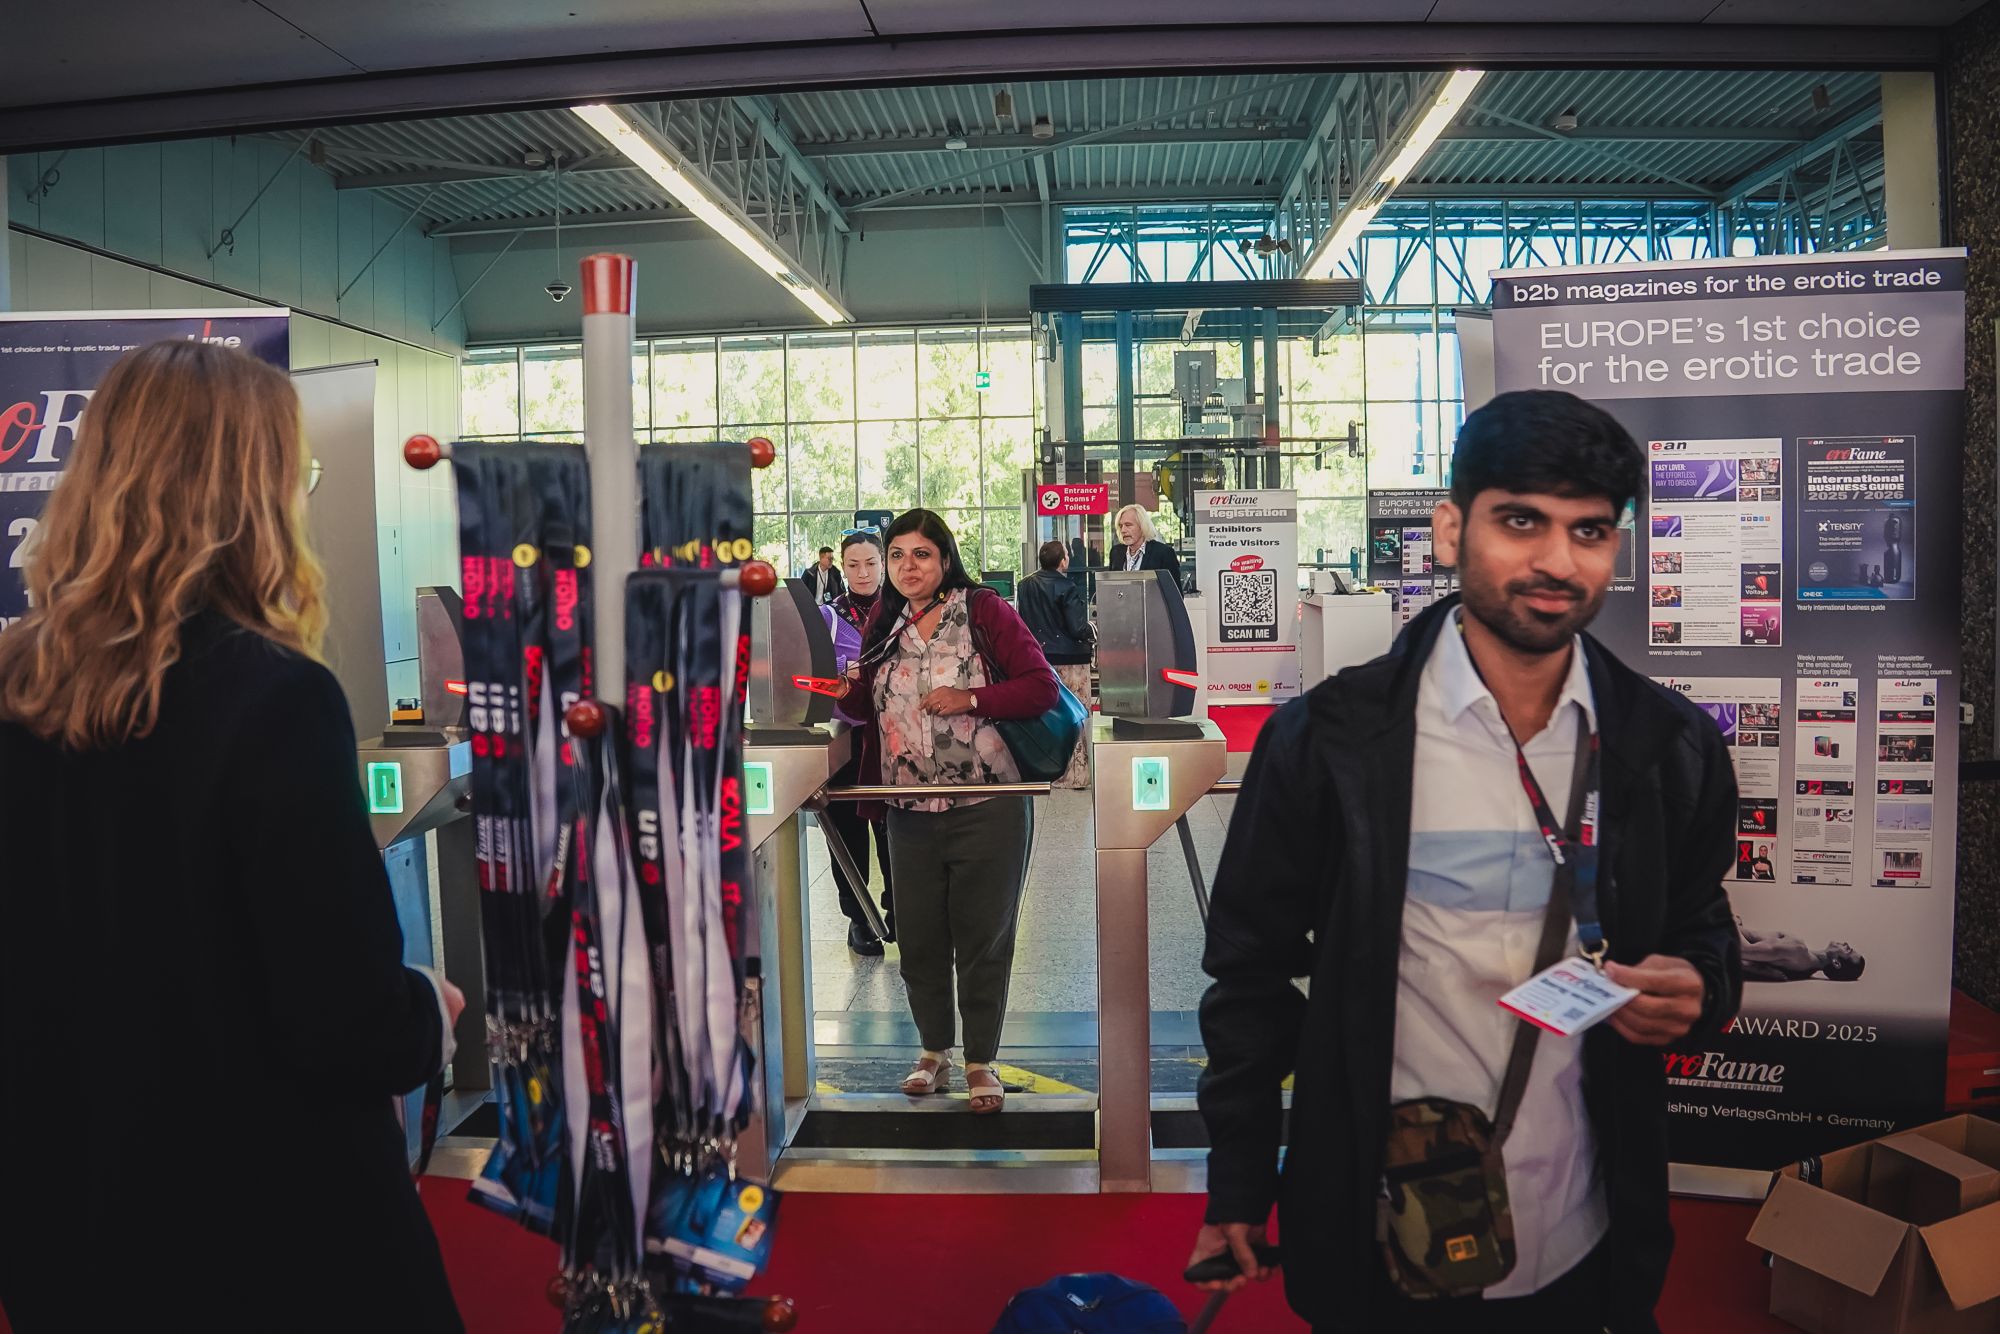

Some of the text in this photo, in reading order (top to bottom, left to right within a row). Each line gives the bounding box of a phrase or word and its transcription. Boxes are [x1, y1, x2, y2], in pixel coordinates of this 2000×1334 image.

[1513, 268, 1942, 302] b2b magazines for the erotic trade
[1540, 311, 1921, 349] EUROPE's 1st choice
[14, 345, 42, 353] choice
[43, 345, 55, 353] for
[57, 344, 71, 352] the
[72, 344, 97, 352] erotic
[98, 343, 121, 352] trade
[1538, 346, 1922, 385] for the erotic trade
[1651, 441, 1688, 451] ean
[1808, 483, 1904, 491] BUSINESS GUIDE
[1808, 491, 1848, 501] 2025
[1863, 490, 1904, 500] 2026
[1422, 499, 1434, 507] 1st
[1209, 508, 1288, 519] Registration
[1378, 508, 1392, 516] for
[1393, 507, 1408, 515] the
[1208, 525, 1262, 533] Exhibitors
[1227, 629, 1270, 639] SCAN ME
[1207, 683, 1225, 691] CALA
[1228, 683, 1252, 692] ORION
[1814, 680, 1839, 688] ean
[1728, 1016, 1878, 1042] AWARD 2025
[1663, 1051, 1785, 1083] roFame
[1712, 1105, 1812, 1124] VerlagsGmbH
[1827, 1114, 1896, 1132] Germany
